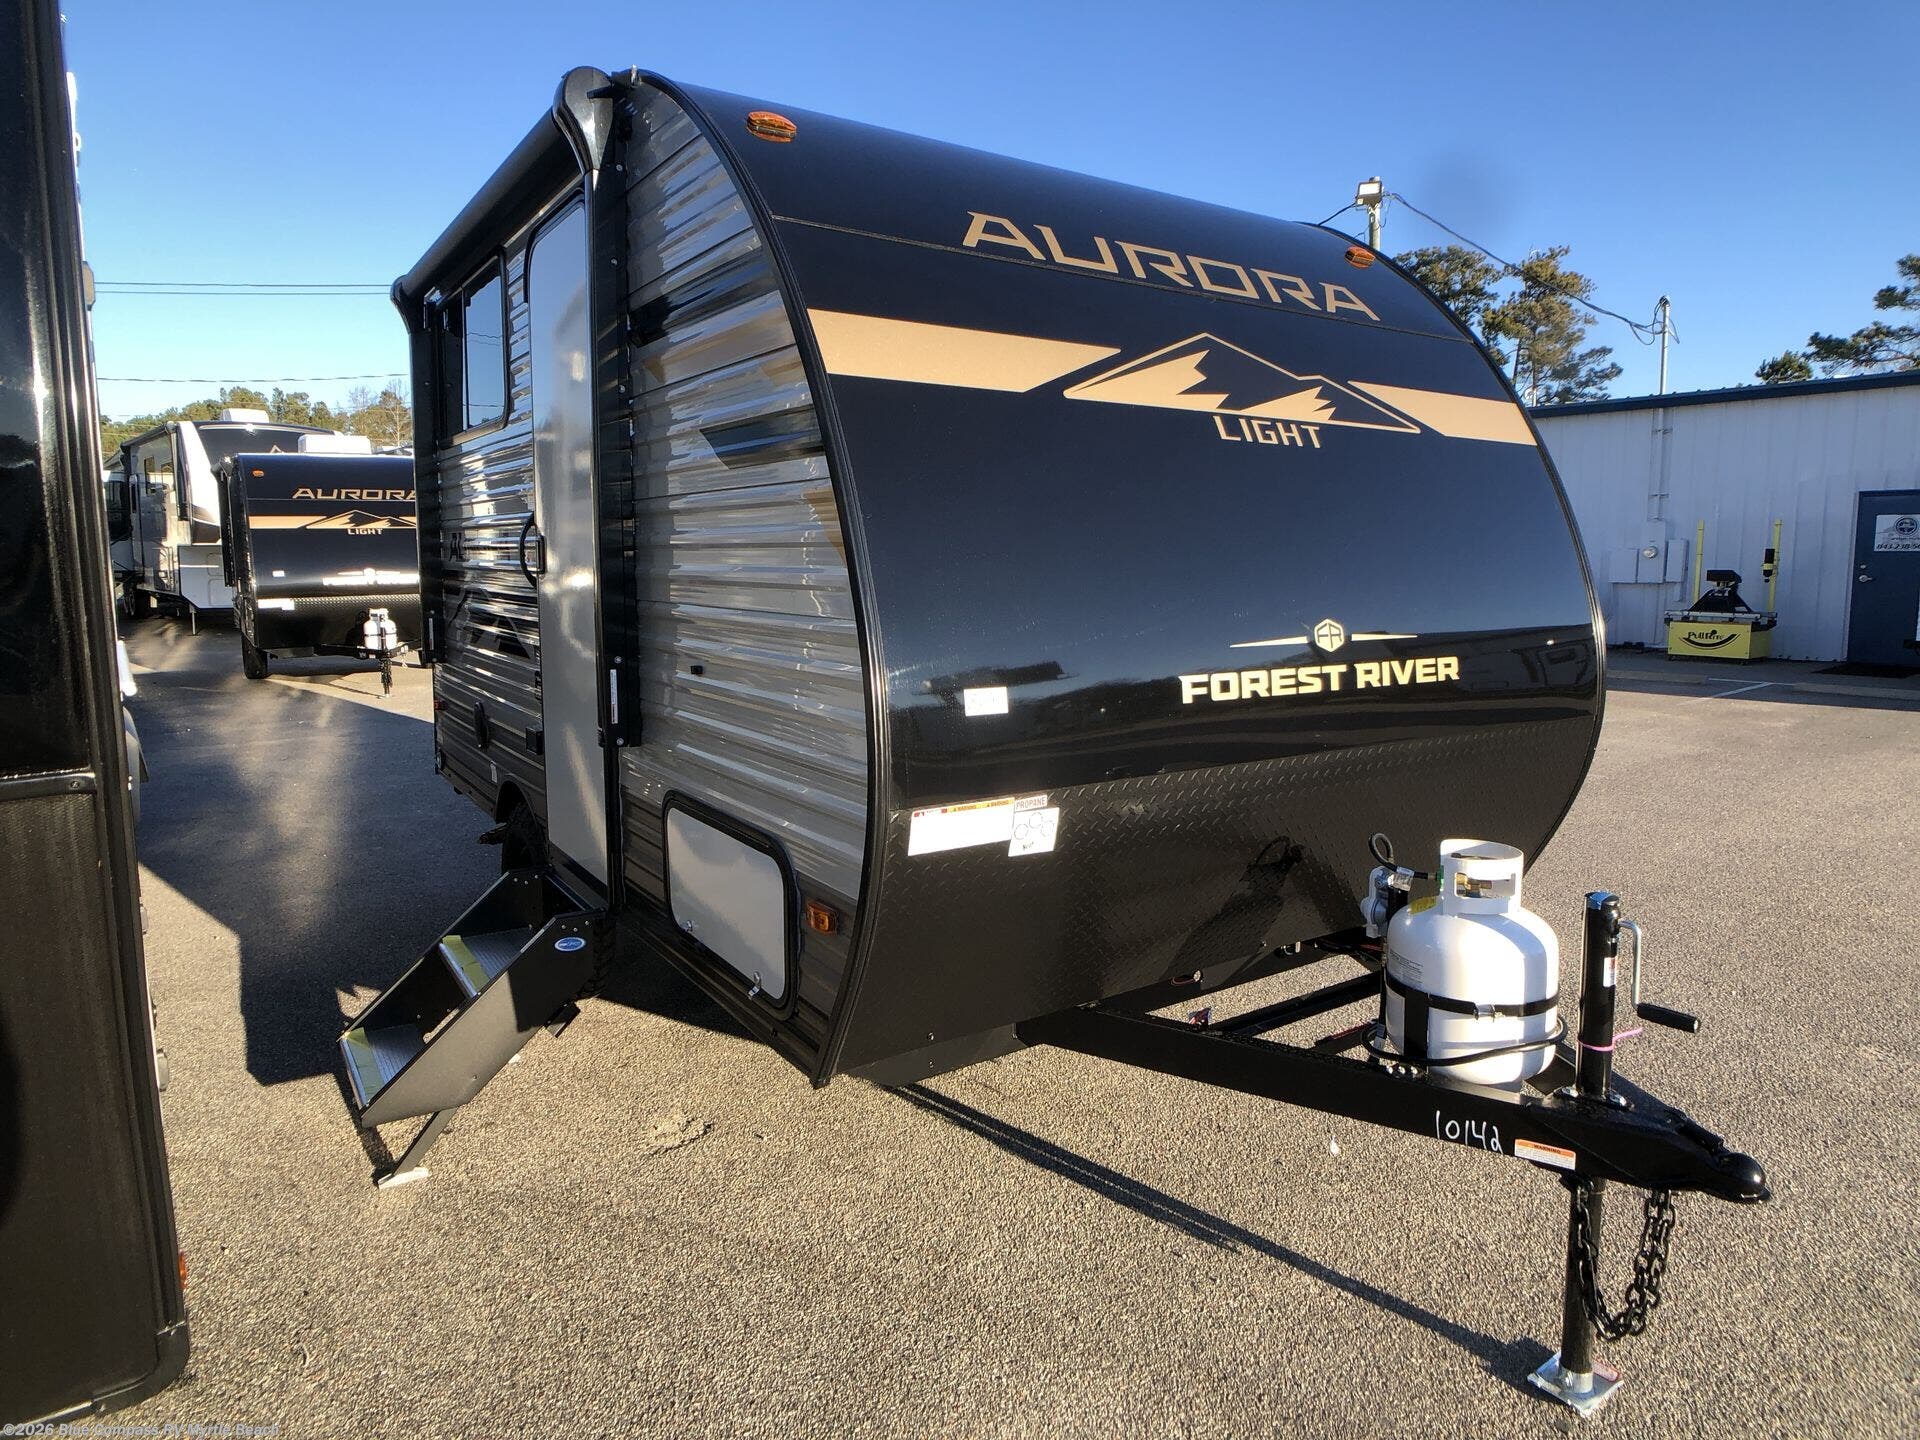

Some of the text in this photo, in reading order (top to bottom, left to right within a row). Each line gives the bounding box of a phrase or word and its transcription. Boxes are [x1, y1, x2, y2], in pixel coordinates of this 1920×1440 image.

[963, 211, 1381, 321] AURORA
[1213, 415, 1321, 448] LIGHT
[1178, 656, 1460, 704] FOREST RIVER
[1016, 796, 1047, 810] PROPANE
[1534, 1143, 1561, 1155] WARNING
